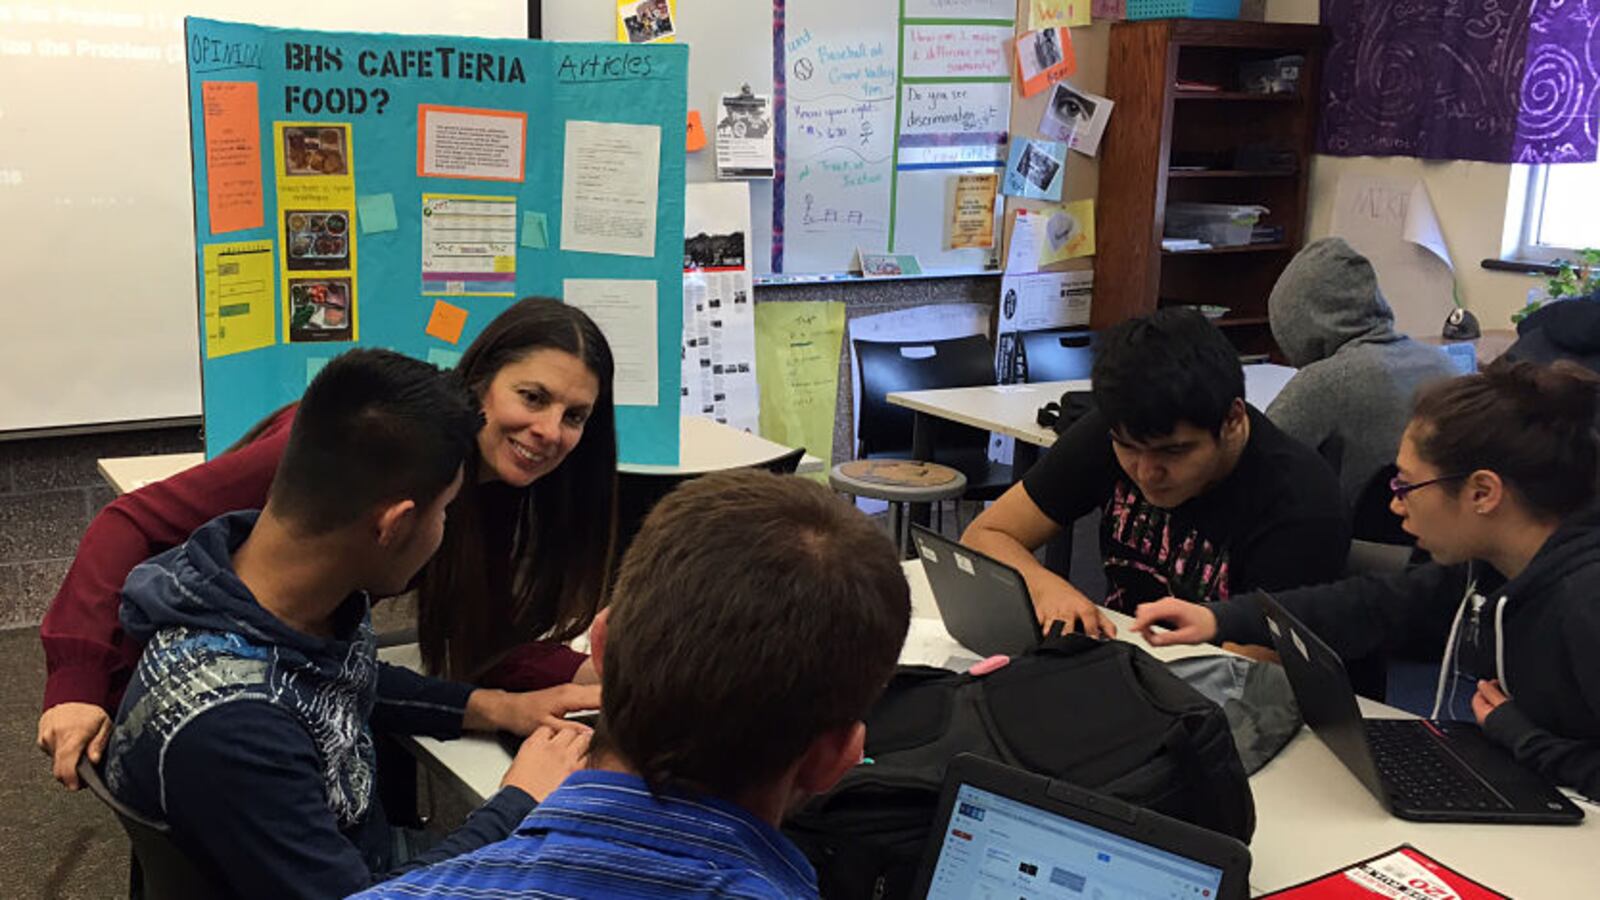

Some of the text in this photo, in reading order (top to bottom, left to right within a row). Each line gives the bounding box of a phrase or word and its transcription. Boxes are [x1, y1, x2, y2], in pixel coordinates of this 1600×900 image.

[284, 42, 527, 84] BHS CAFETERIA
[558, 54, 653, 78] Articles
[284, 86, 390, 115] FOOD?
[908, 87, 967, 110] Do you see
